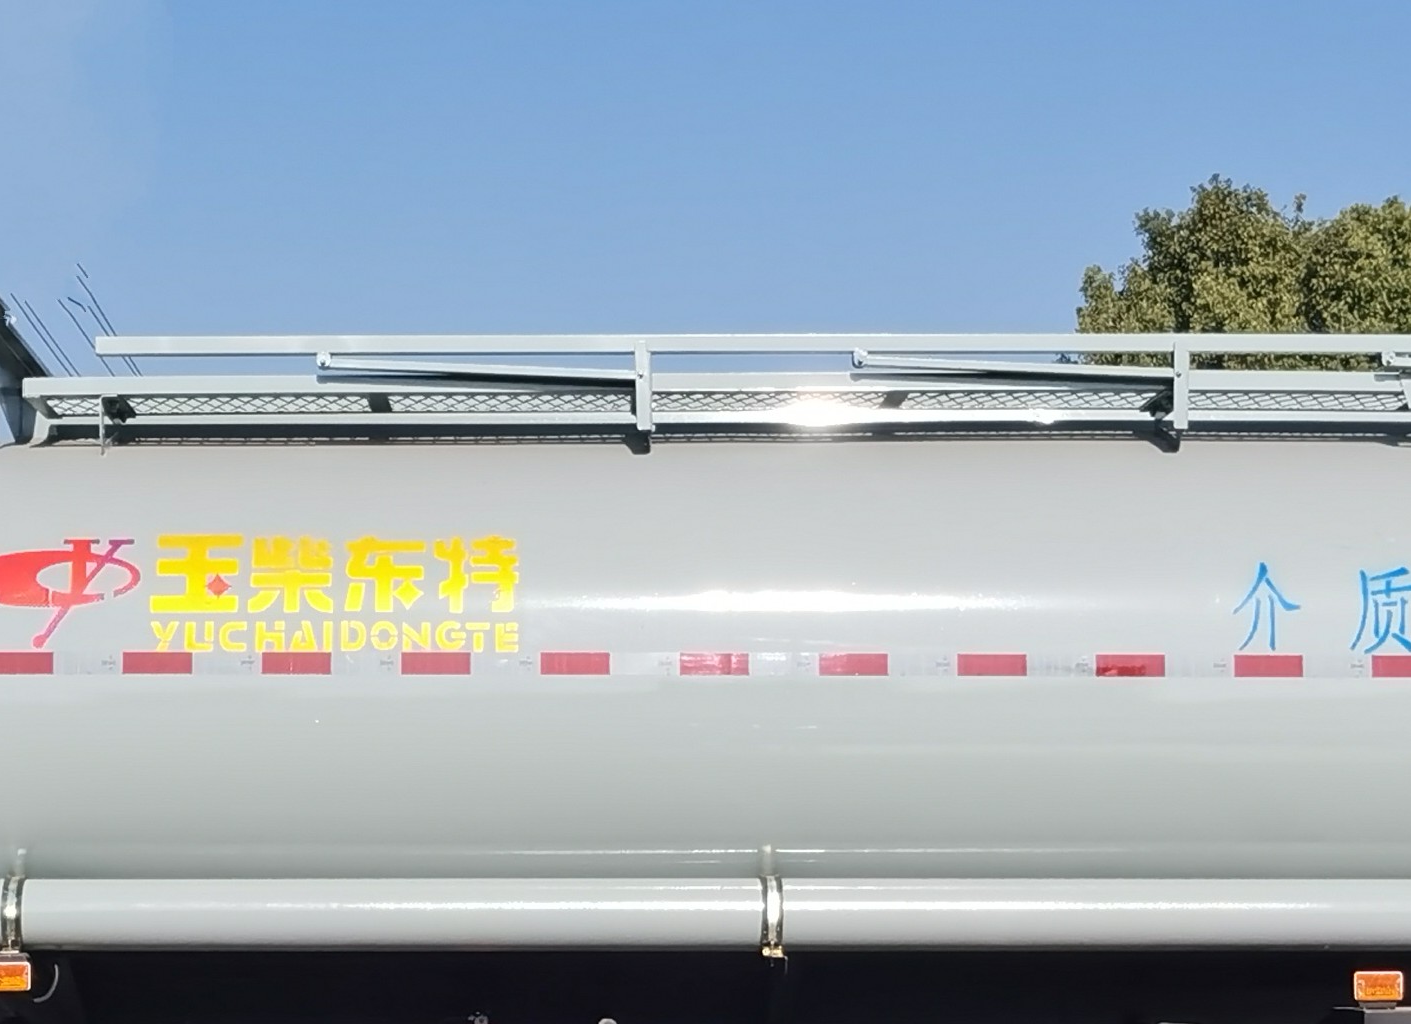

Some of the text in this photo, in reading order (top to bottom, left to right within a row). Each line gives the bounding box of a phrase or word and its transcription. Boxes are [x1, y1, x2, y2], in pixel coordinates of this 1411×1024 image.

[149, 533, 520, 613] 玉柴东特
[150, 620, 520, 652] YUCHAIDONGTE
